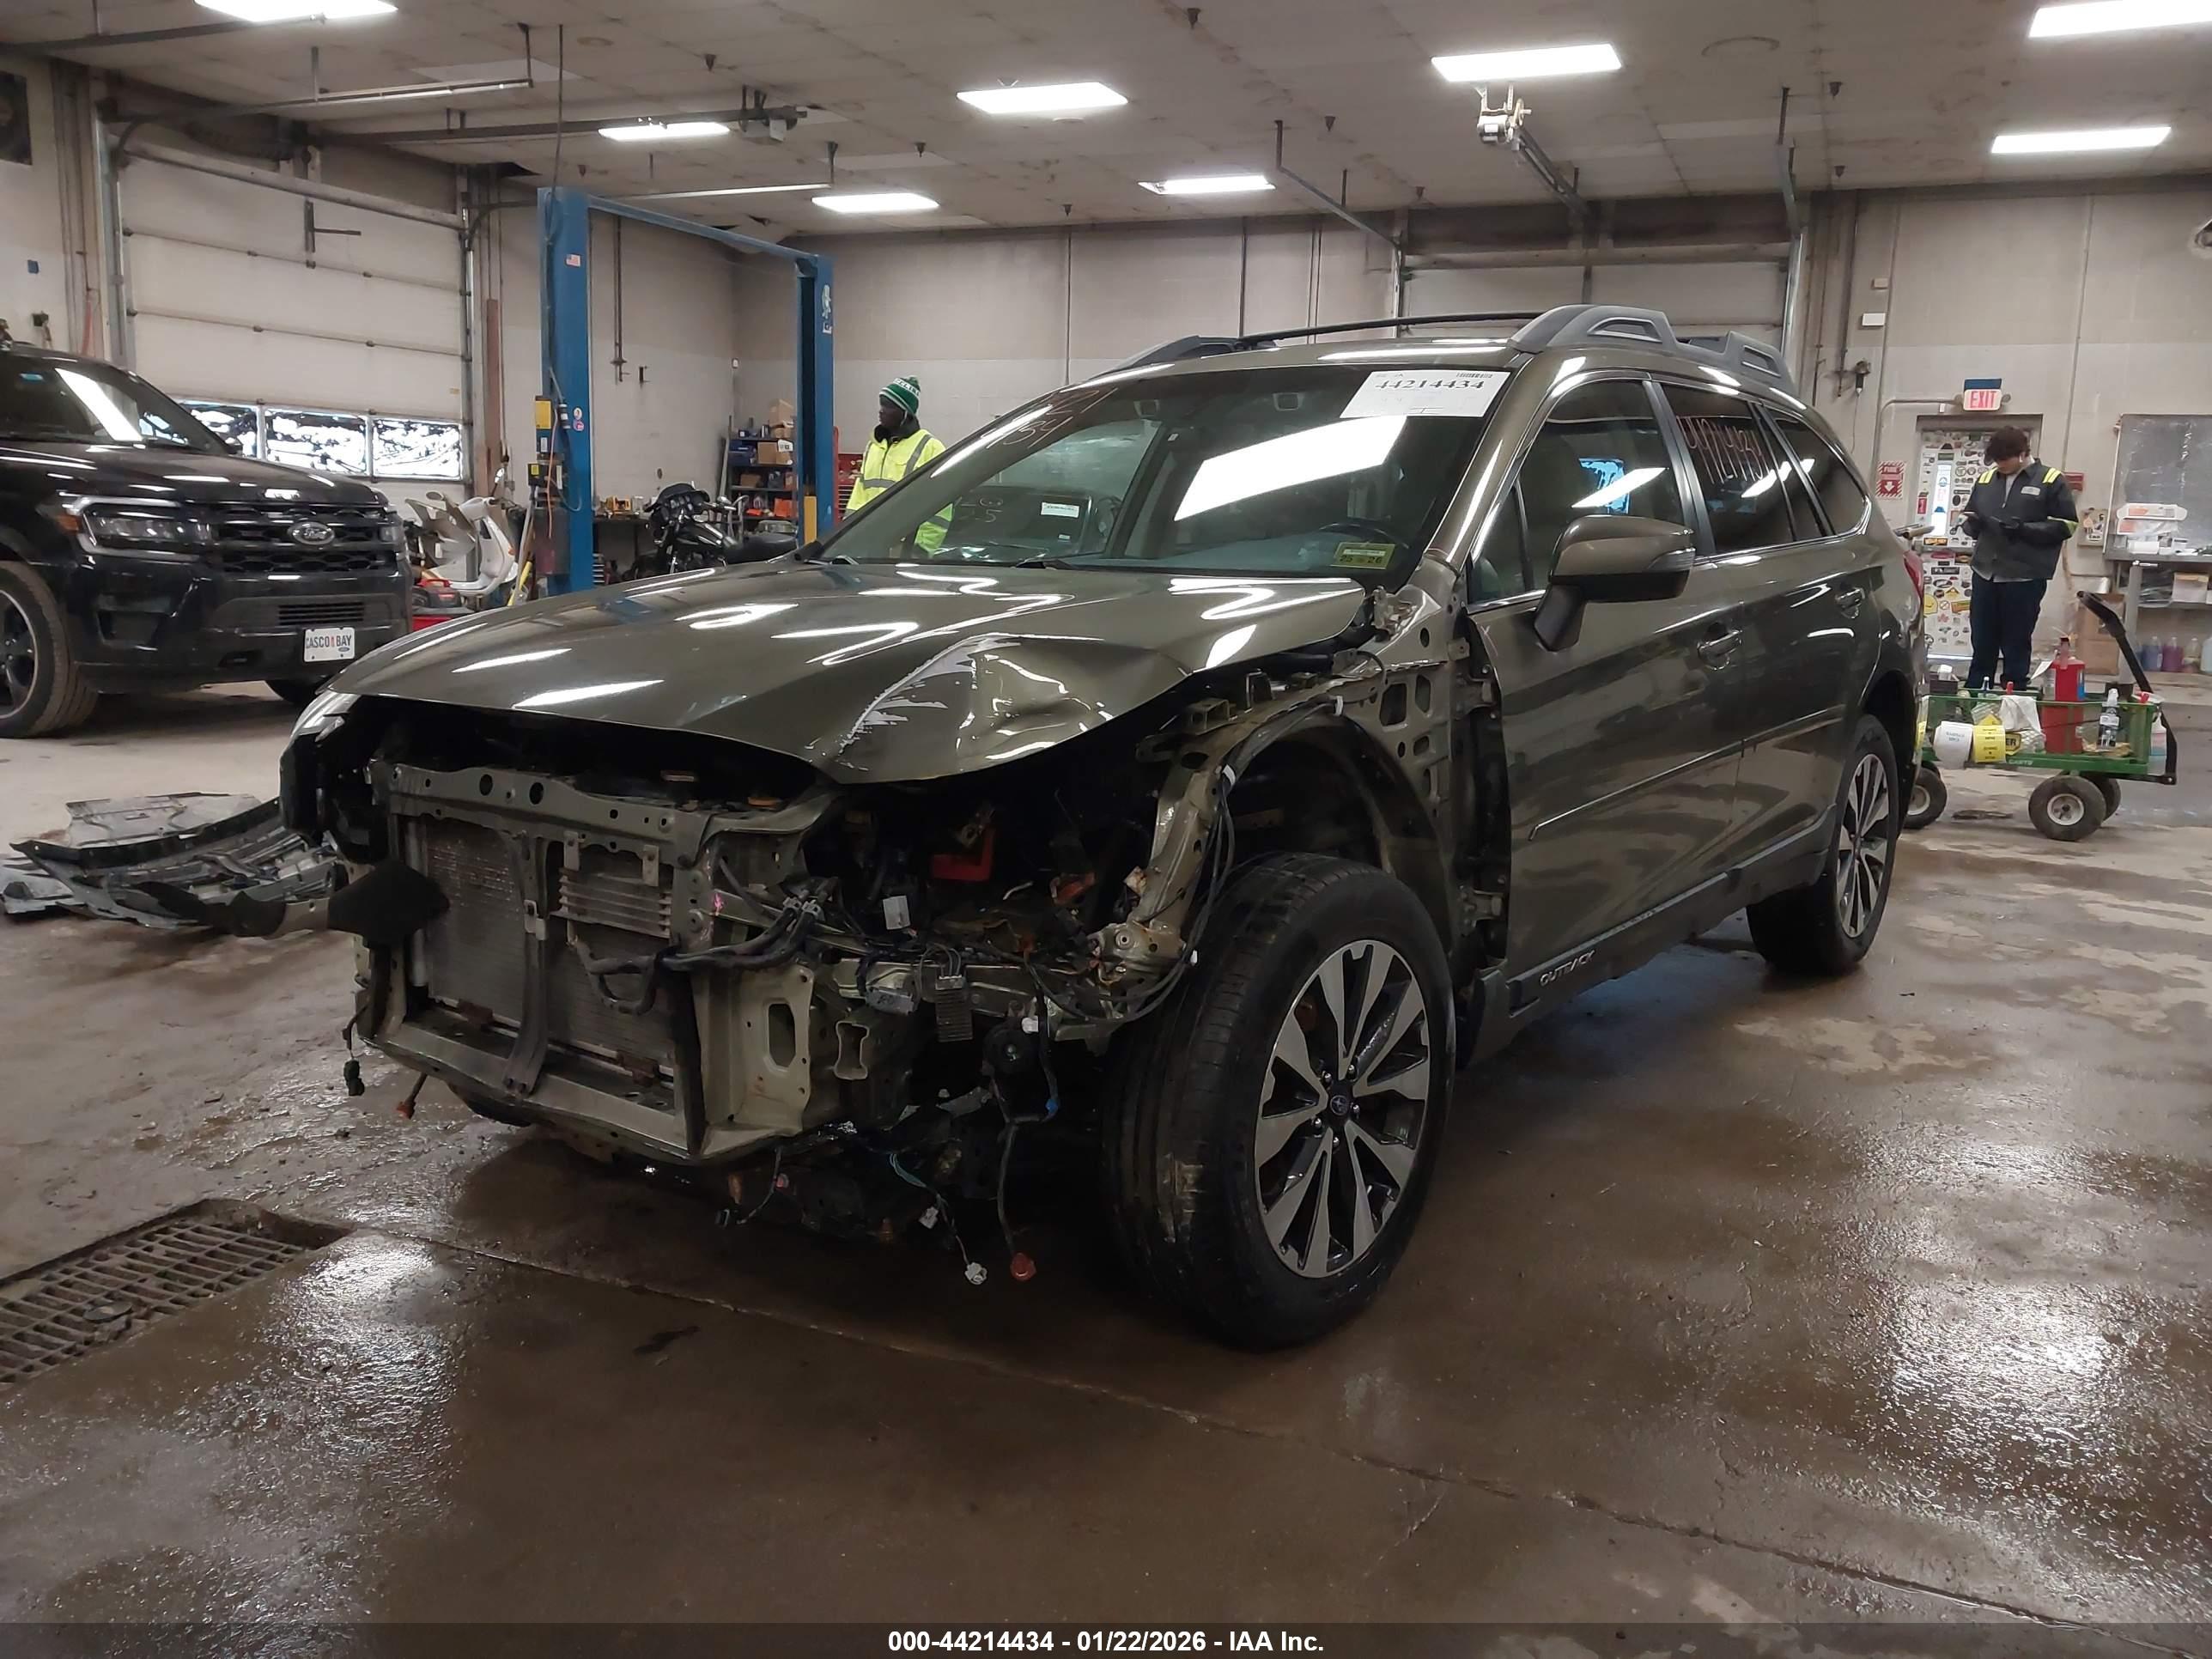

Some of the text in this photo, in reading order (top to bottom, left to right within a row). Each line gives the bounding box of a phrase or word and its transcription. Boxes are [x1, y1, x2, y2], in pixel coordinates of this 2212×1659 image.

[1375, 380, 1485, 389] 44214434
[1970, 391, 1997, 409] EXIT
[336, 635, 352, 647] BAY
